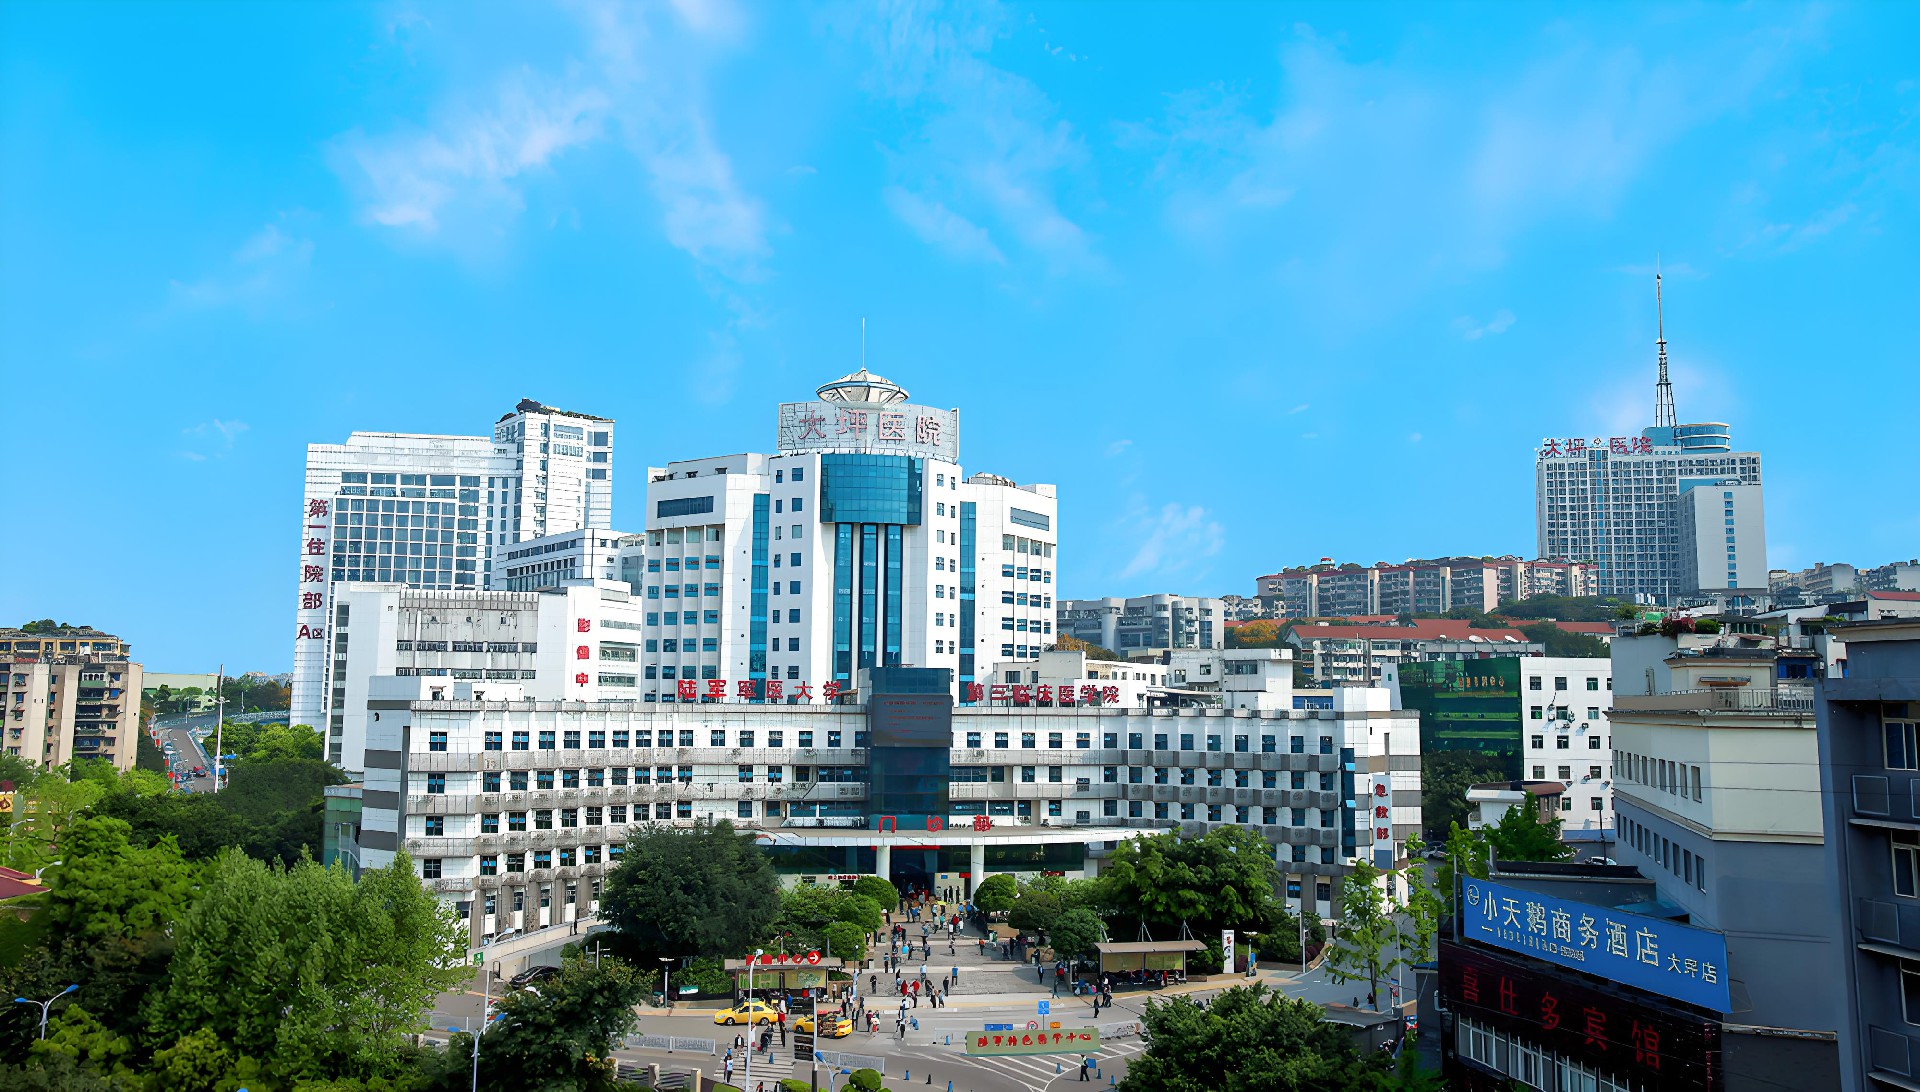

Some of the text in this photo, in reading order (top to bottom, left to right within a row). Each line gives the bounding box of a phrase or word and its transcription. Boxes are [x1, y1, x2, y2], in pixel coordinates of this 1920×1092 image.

[798, 407, 942, 447] 大坪医院
[302, 499, 328, 610] 第一住院部
[1483, 891, 1659, 967] 小天鹅商务酒店
